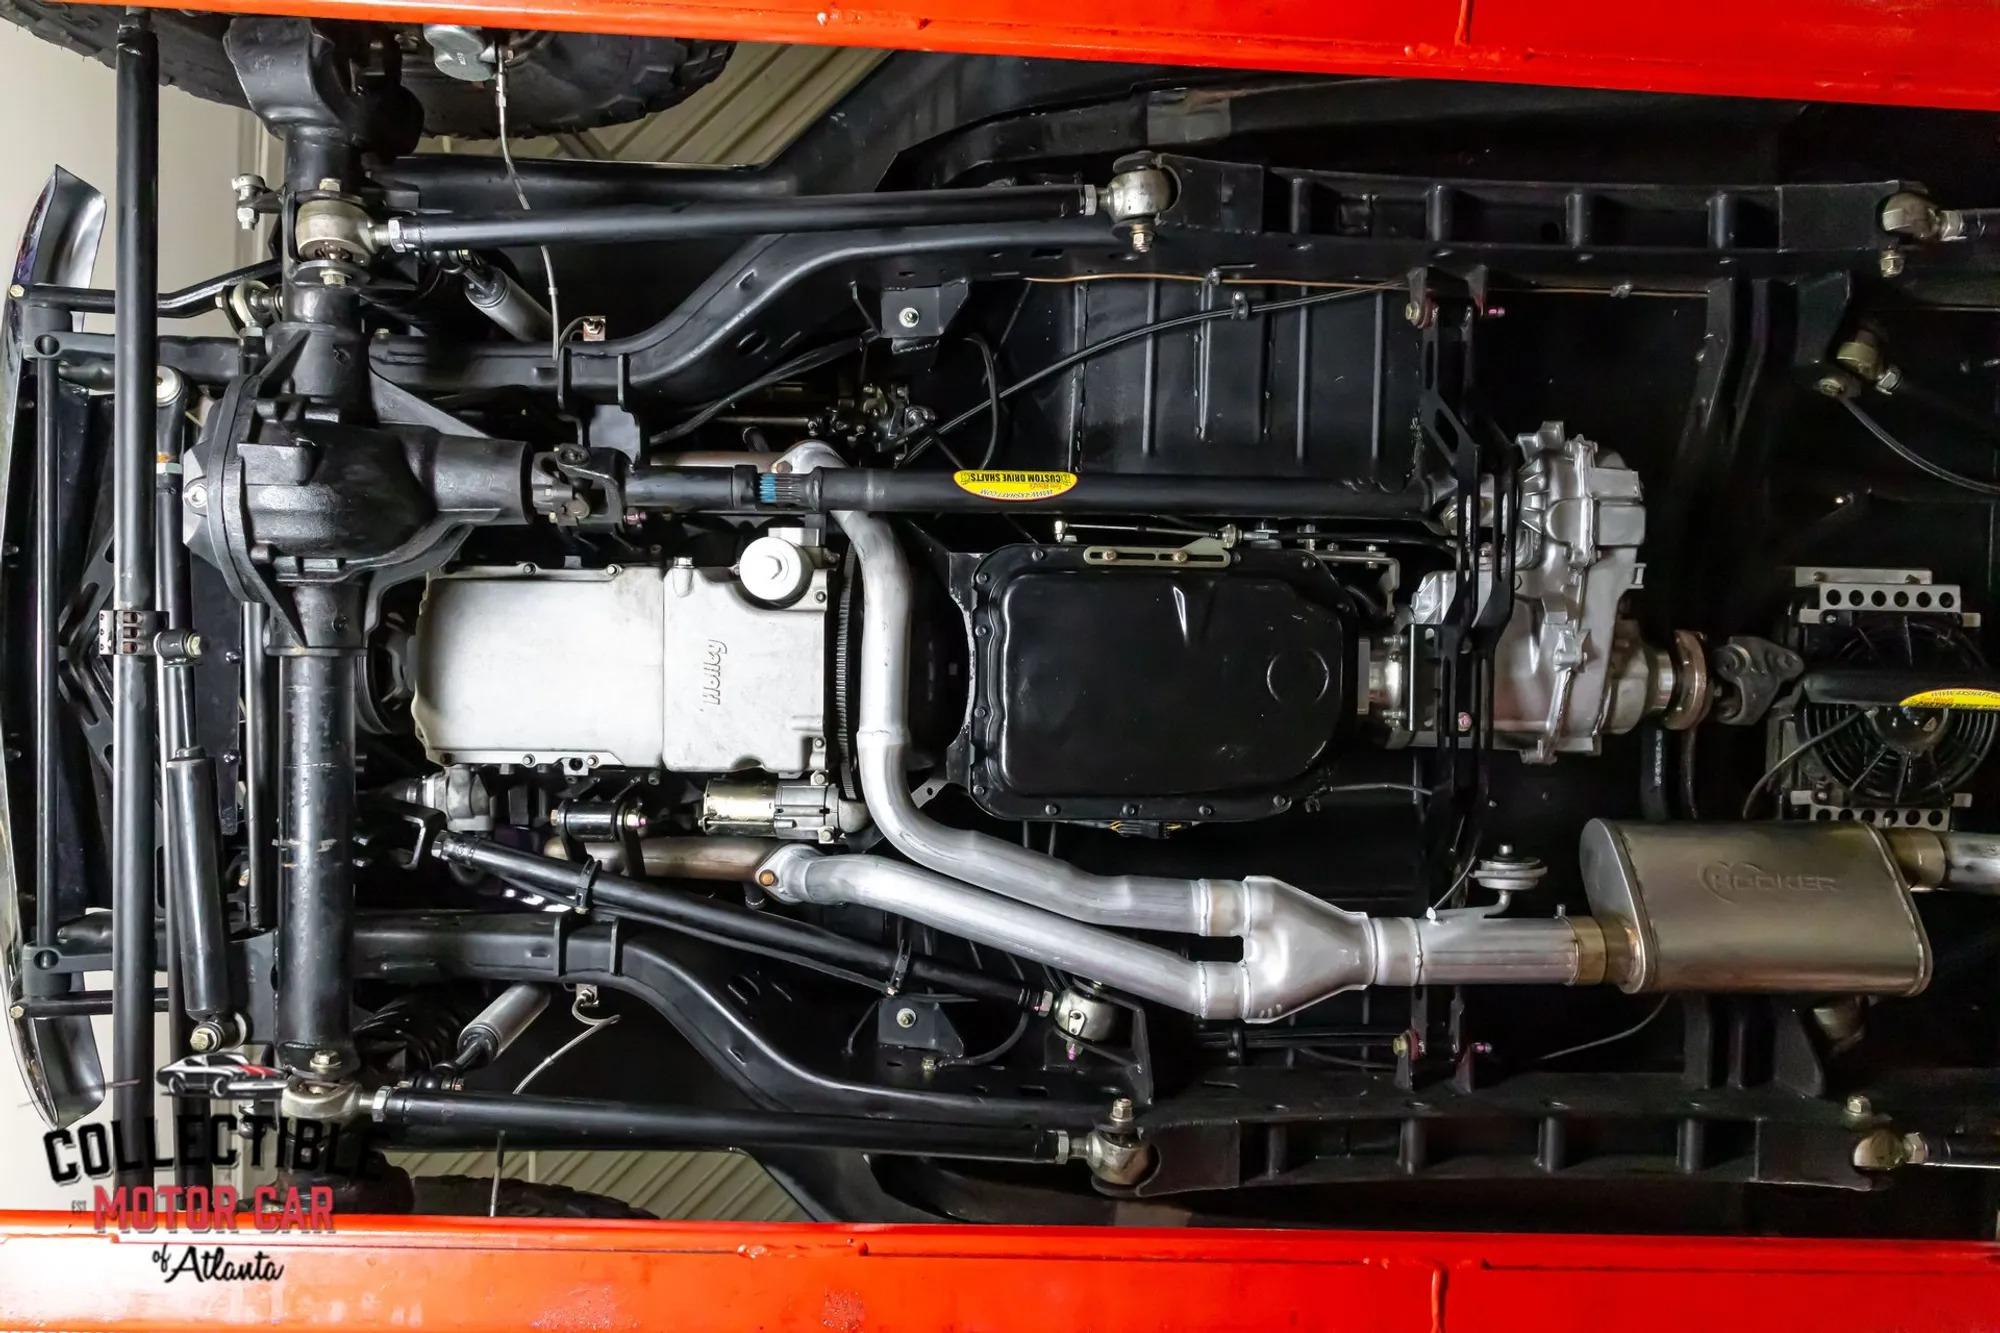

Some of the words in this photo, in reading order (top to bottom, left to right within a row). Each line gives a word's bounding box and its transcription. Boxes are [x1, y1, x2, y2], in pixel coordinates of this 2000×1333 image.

[970, 472, 1000, 481] SHAFTS
[1002, 473, 1026, 482] DRIVE
[1027, 473, 1061, 483] CUSTOM
[703, 639, 728, 705] Holley
[1711, 872, 1840, 891] HOOKER
